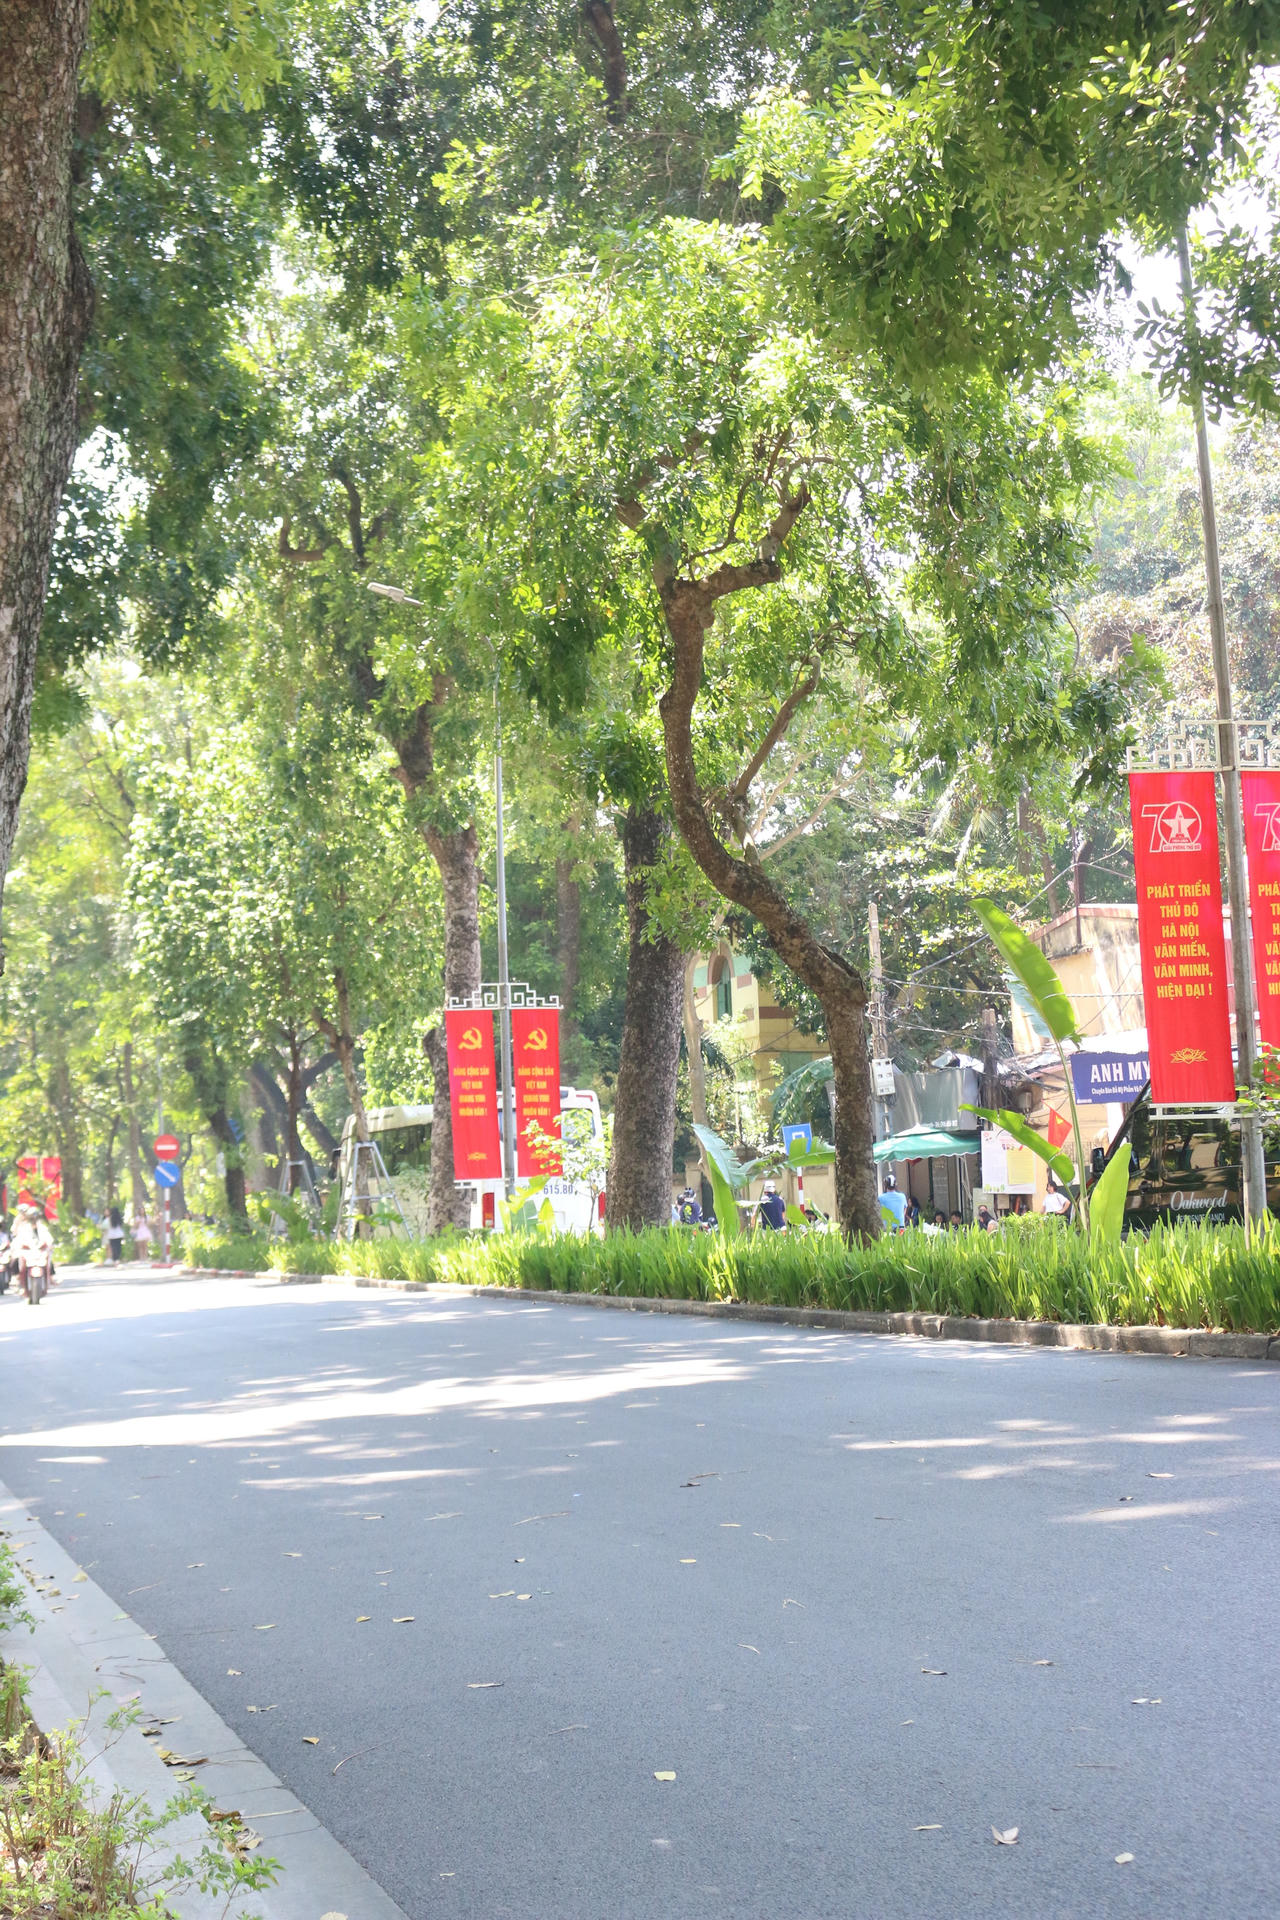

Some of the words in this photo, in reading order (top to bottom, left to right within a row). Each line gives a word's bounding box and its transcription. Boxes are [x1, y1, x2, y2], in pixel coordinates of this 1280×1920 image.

[1254, 803, 1280, 851] 7
[1146, 883, 1175, 899] PHÁT
[1178, 880, 1211, 897] TRIỂN
[1257, 881, 1280, 897] PHÁ
[1160, 901, 1181, 918] THỦ
[1184, 902, 1199, 917] ĐÔ
[1161, 922, 1177, 938] HÀ
[1179, 922, 1199, 940] NỘI
[1154, 943, 1177, 959] VĂN
[1180, 940, 1210, 957] HIẾN,
[1265, 940, 1280, 956] VĂ
[1153, 963, 1176, 979] VĂN
[1179, 963, 1213, 977] MINH,
[1265, 960, 1280, 976] VĂ
[1156, 983, 1183, 1000] HIỆN
[1185, 983, 1205, 999] ĐẠI
[1208, 983, 1212, 995] !
[1090, 1062, 1124, 1083] ANH
[1170, 1189, 1228, 1211] Oakwood
